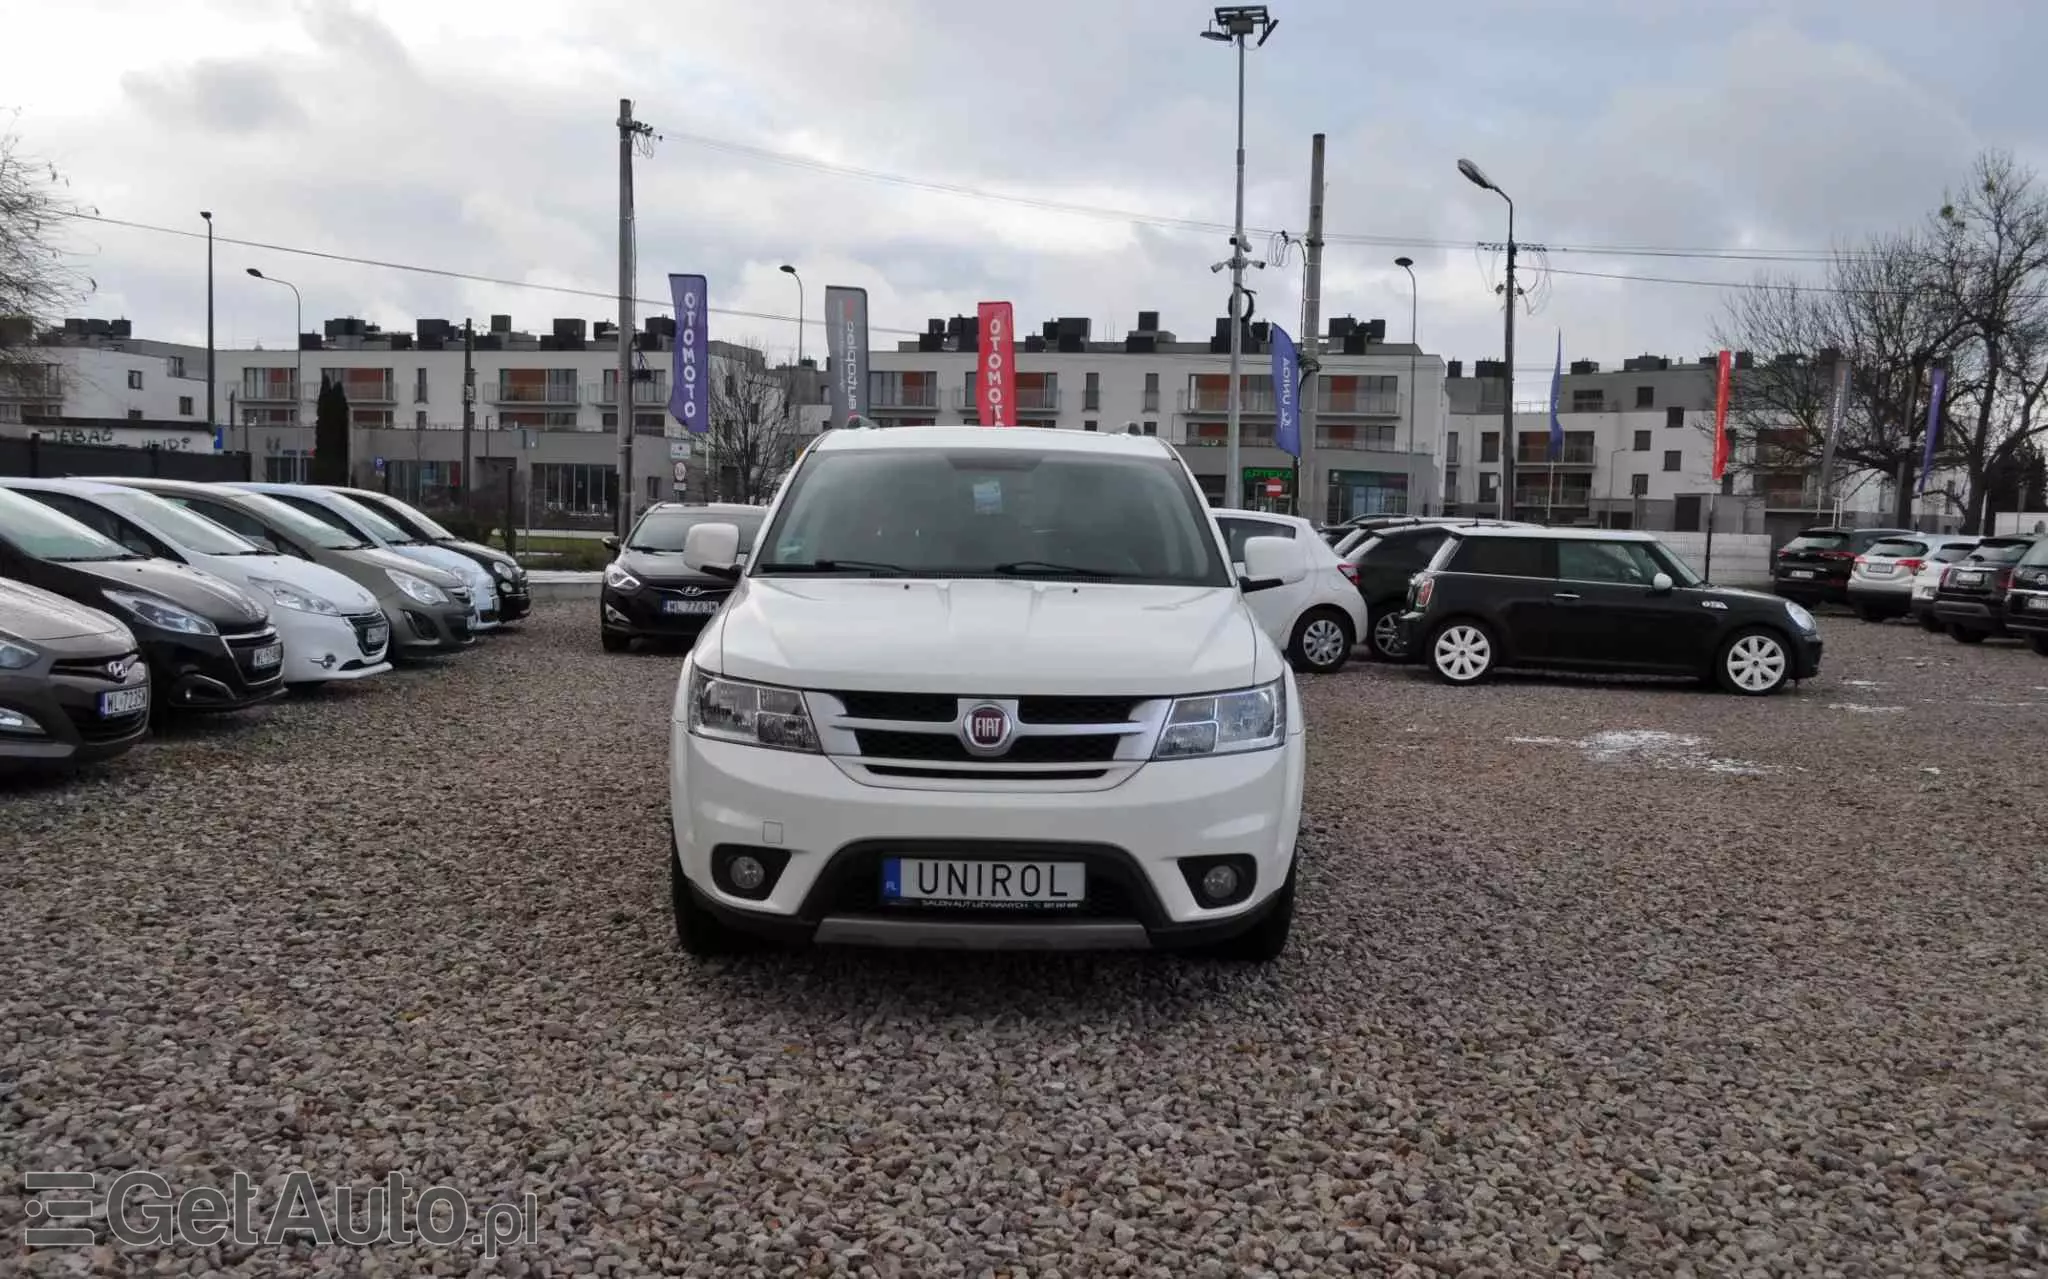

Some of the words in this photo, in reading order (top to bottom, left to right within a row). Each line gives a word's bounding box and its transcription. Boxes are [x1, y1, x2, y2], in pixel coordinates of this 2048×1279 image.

[682, 291, 697, 418] OTOMOTO
[975, 717, 1002, 737] FIAT
[918, 862, 1069, 897] UNIROL
